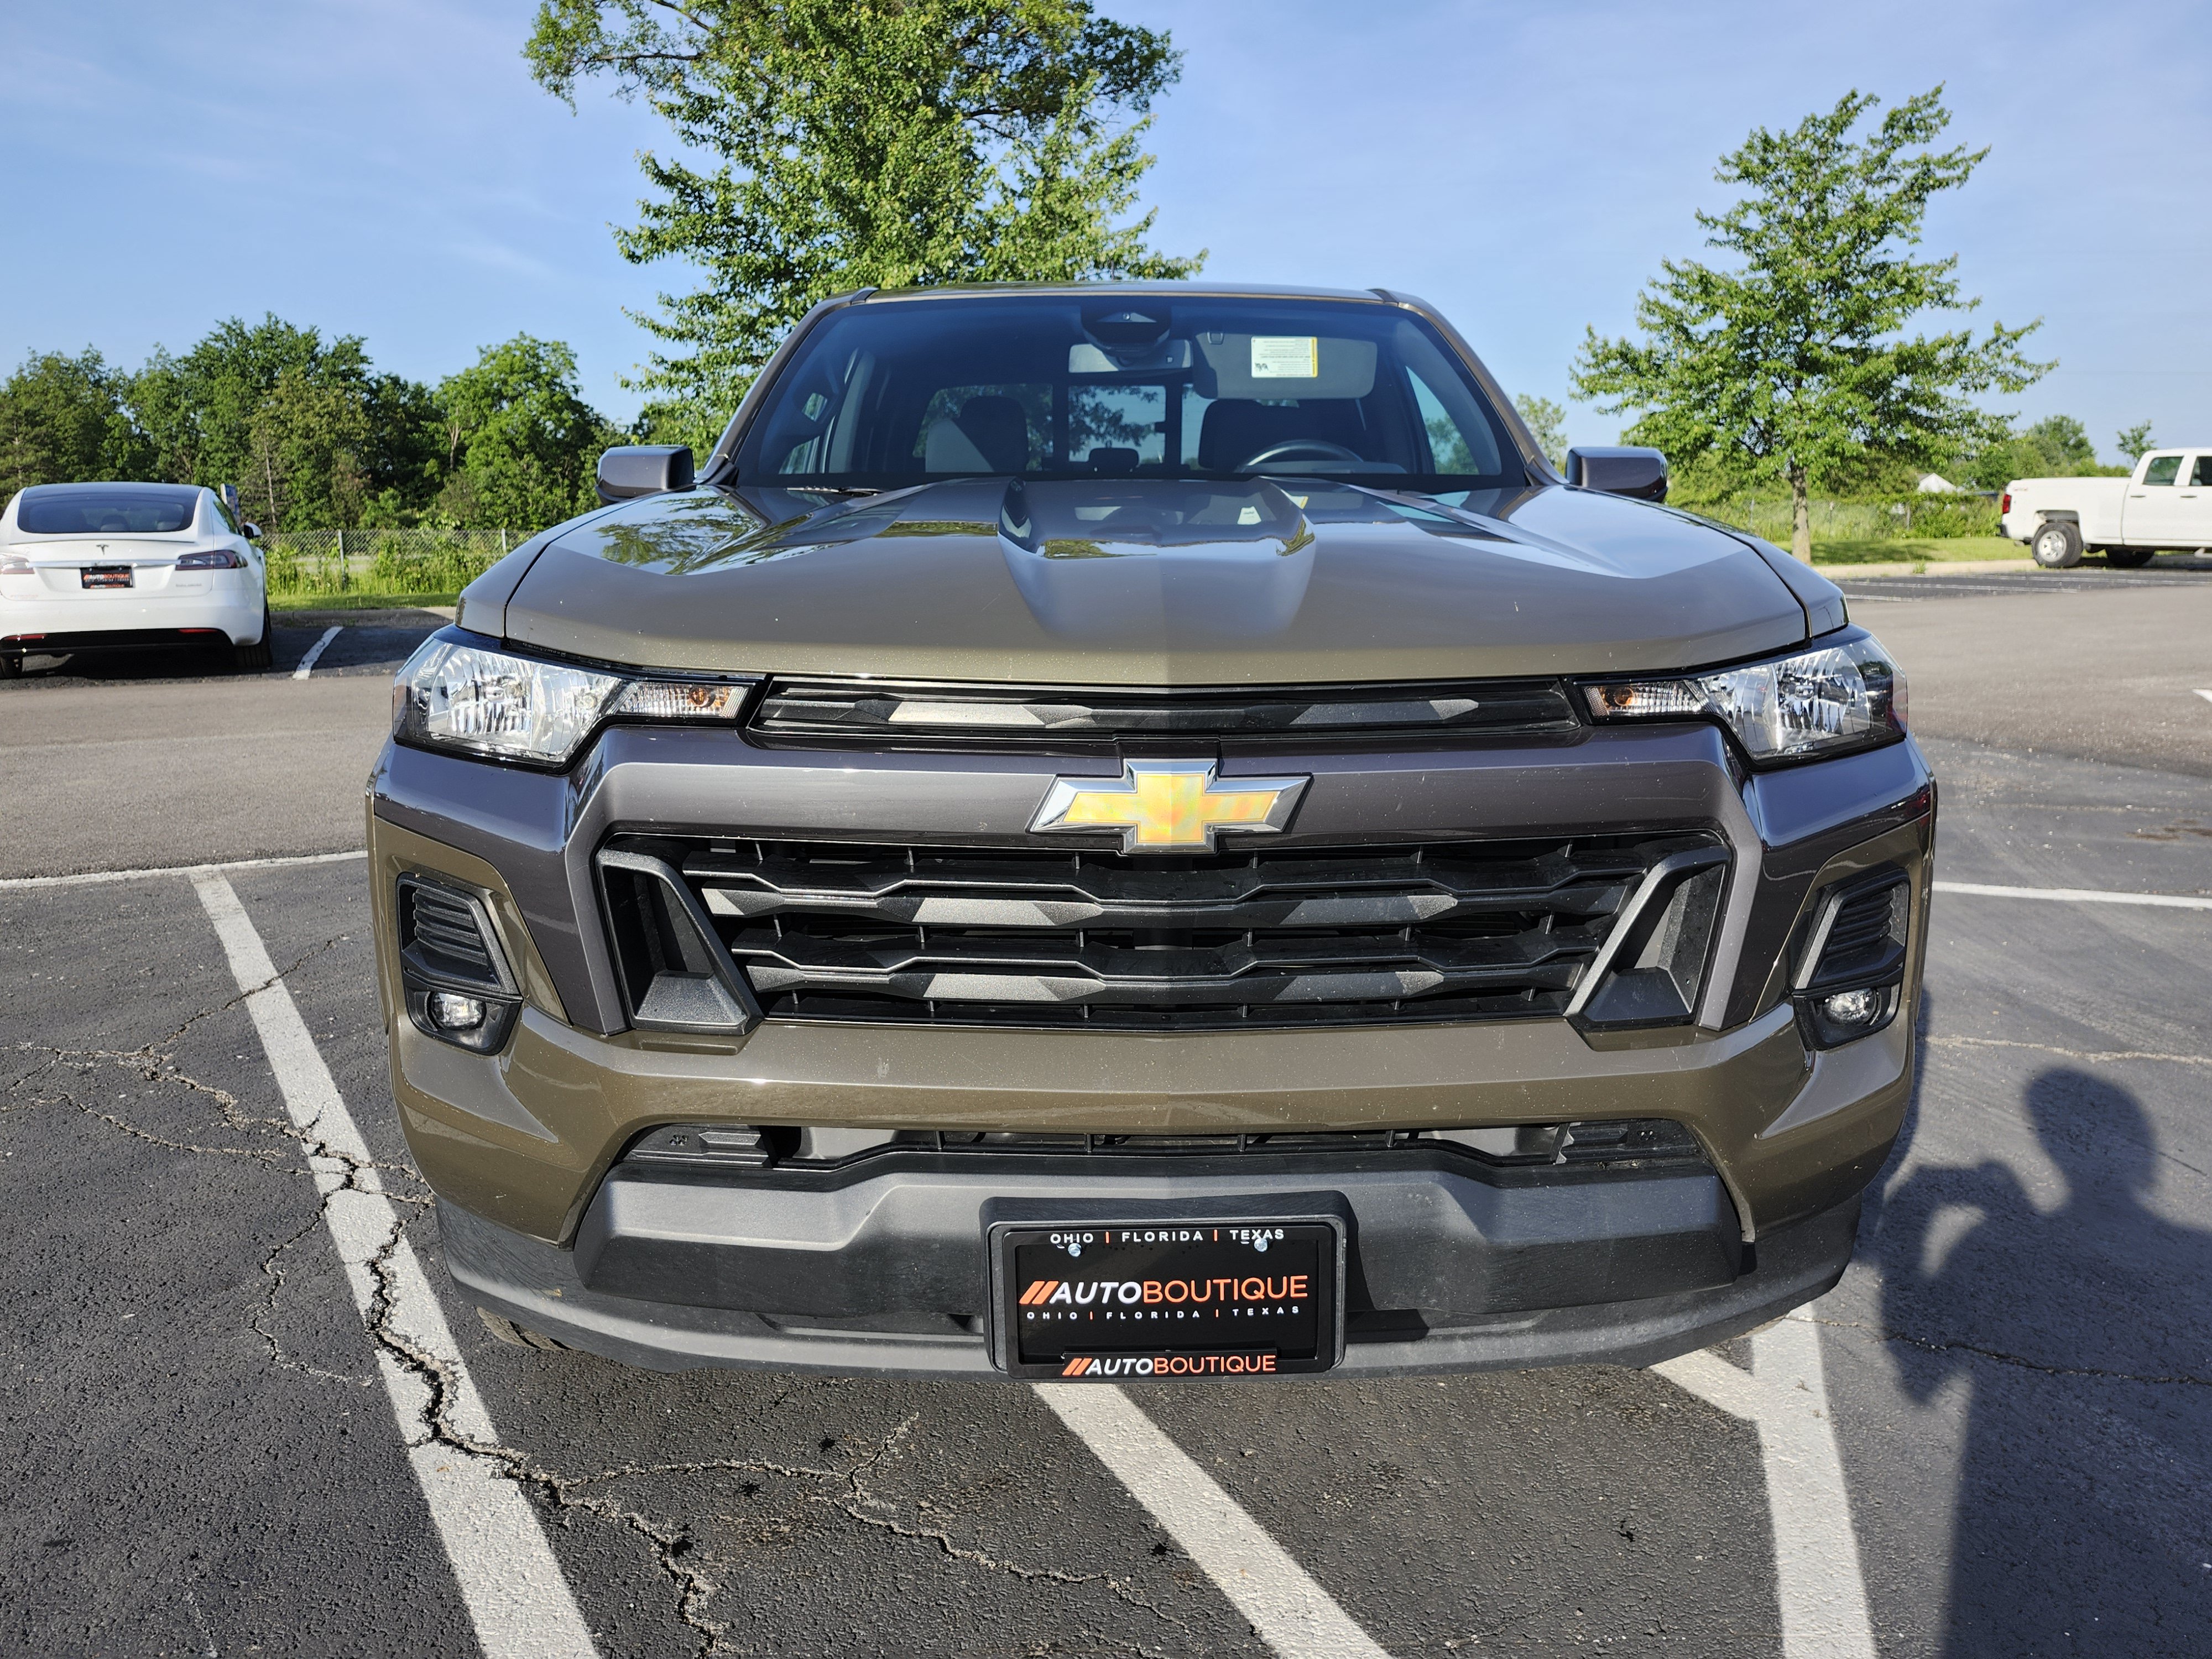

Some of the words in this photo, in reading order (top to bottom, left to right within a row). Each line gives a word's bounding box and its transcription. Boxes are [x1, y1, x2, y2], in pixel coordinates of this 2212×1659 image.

[1051, 1233, 1094, 1244] OHIO
[1122, 1231, 1203, 1243] FLORIDA
[1229, 1229, 1284, 1240] TEXAS
[1049, 1275, 1308, 1304] AUTOBOUTIQUE
[1027, 1311, 1078, 1320] OHIO
[1106, 1310, 1200, 1320] FLORIDA
[1232, 1306, 1299, 1317] TEXAS
[1085, 1355, 1276, 1375] AUTOBOUTIQUE
